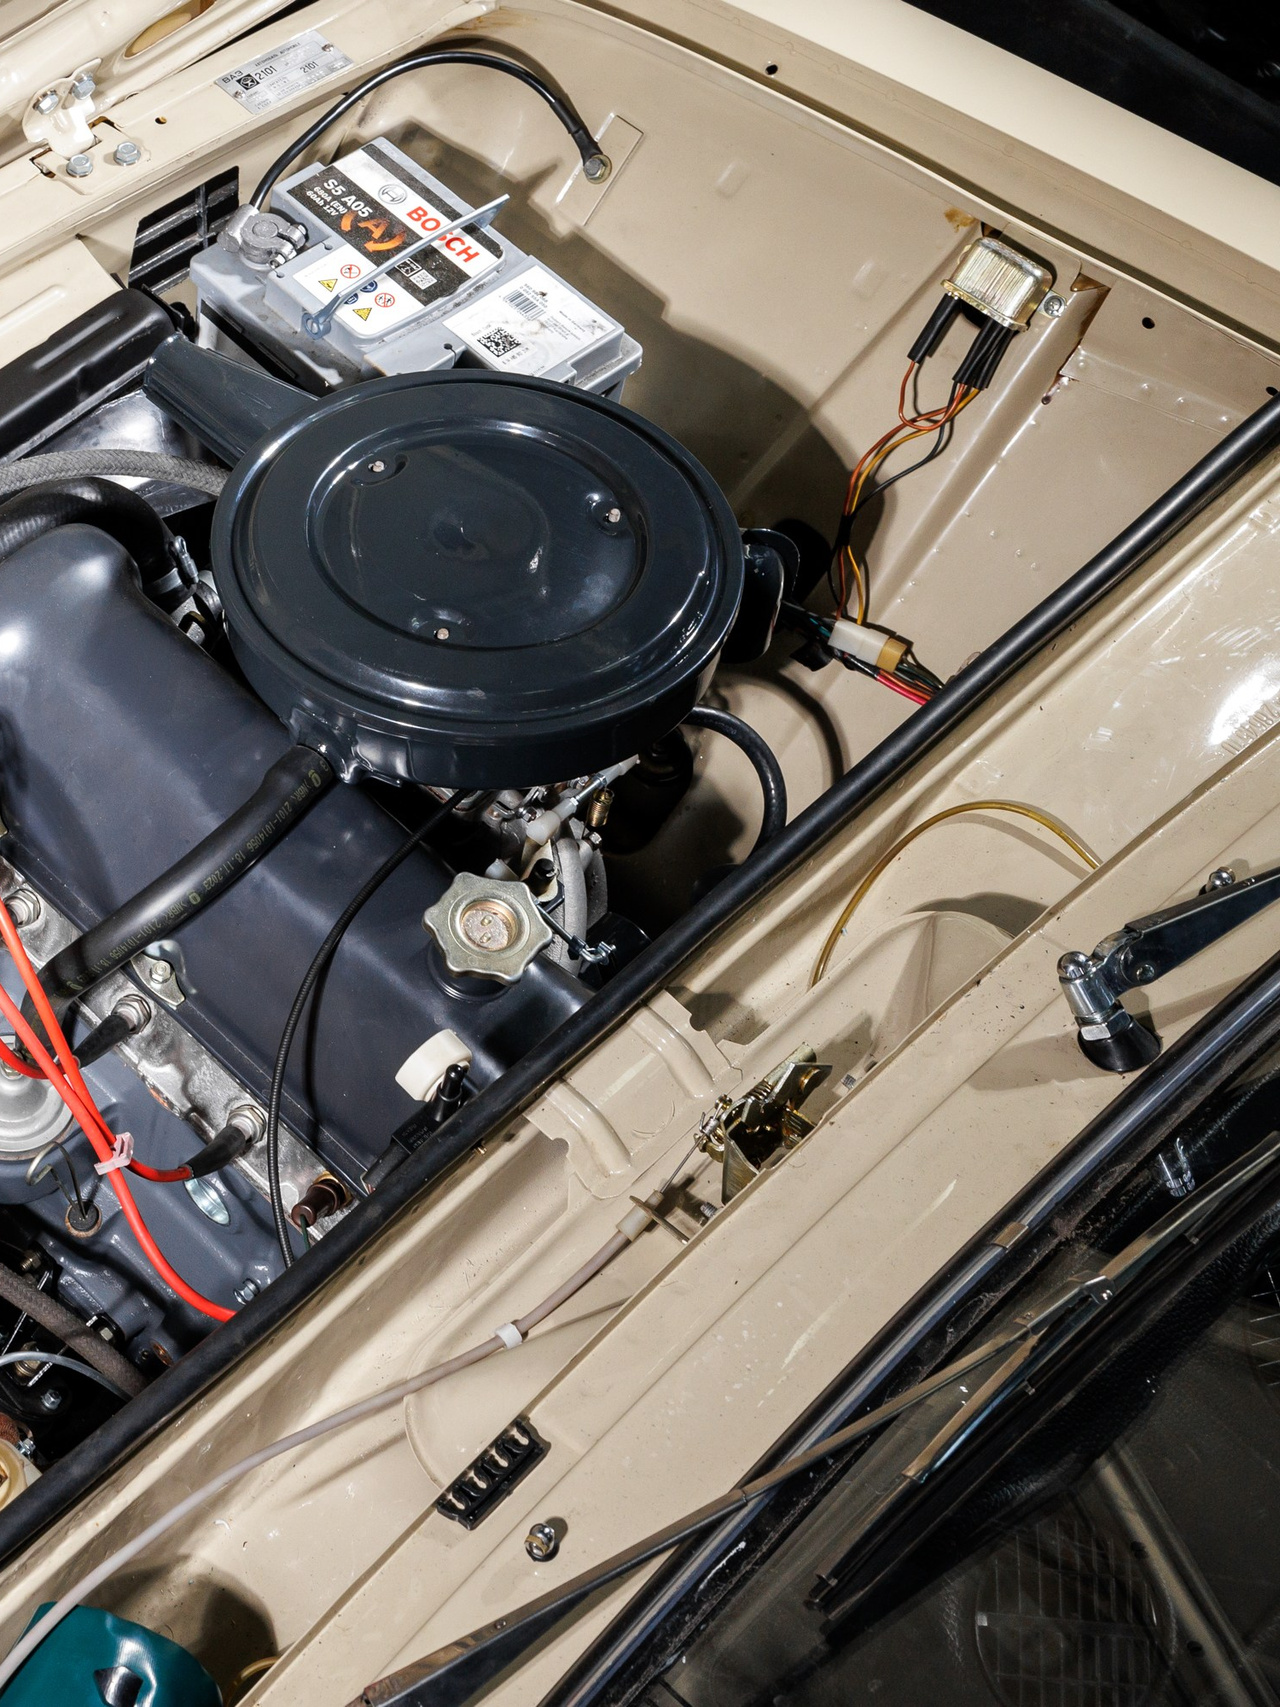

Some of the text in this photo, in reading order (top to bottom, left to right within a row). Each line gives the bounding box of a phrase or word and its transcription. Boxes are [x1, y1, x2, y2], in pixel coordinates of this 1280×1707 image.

[222, 70, 243, 84] ВАЗ
[255, 65, 277, 81] 2101
[300, 61, 319, 74] 2101
[306, 190, 339, 216] 60Ah 12V
[314, 186, 347, 215] 680A (EN)
[323, 178, 373, 218] S5 A05
[245, 800, 293, 852] 2101-1014056
[202, 849, 246, 890] 18.11.2023
